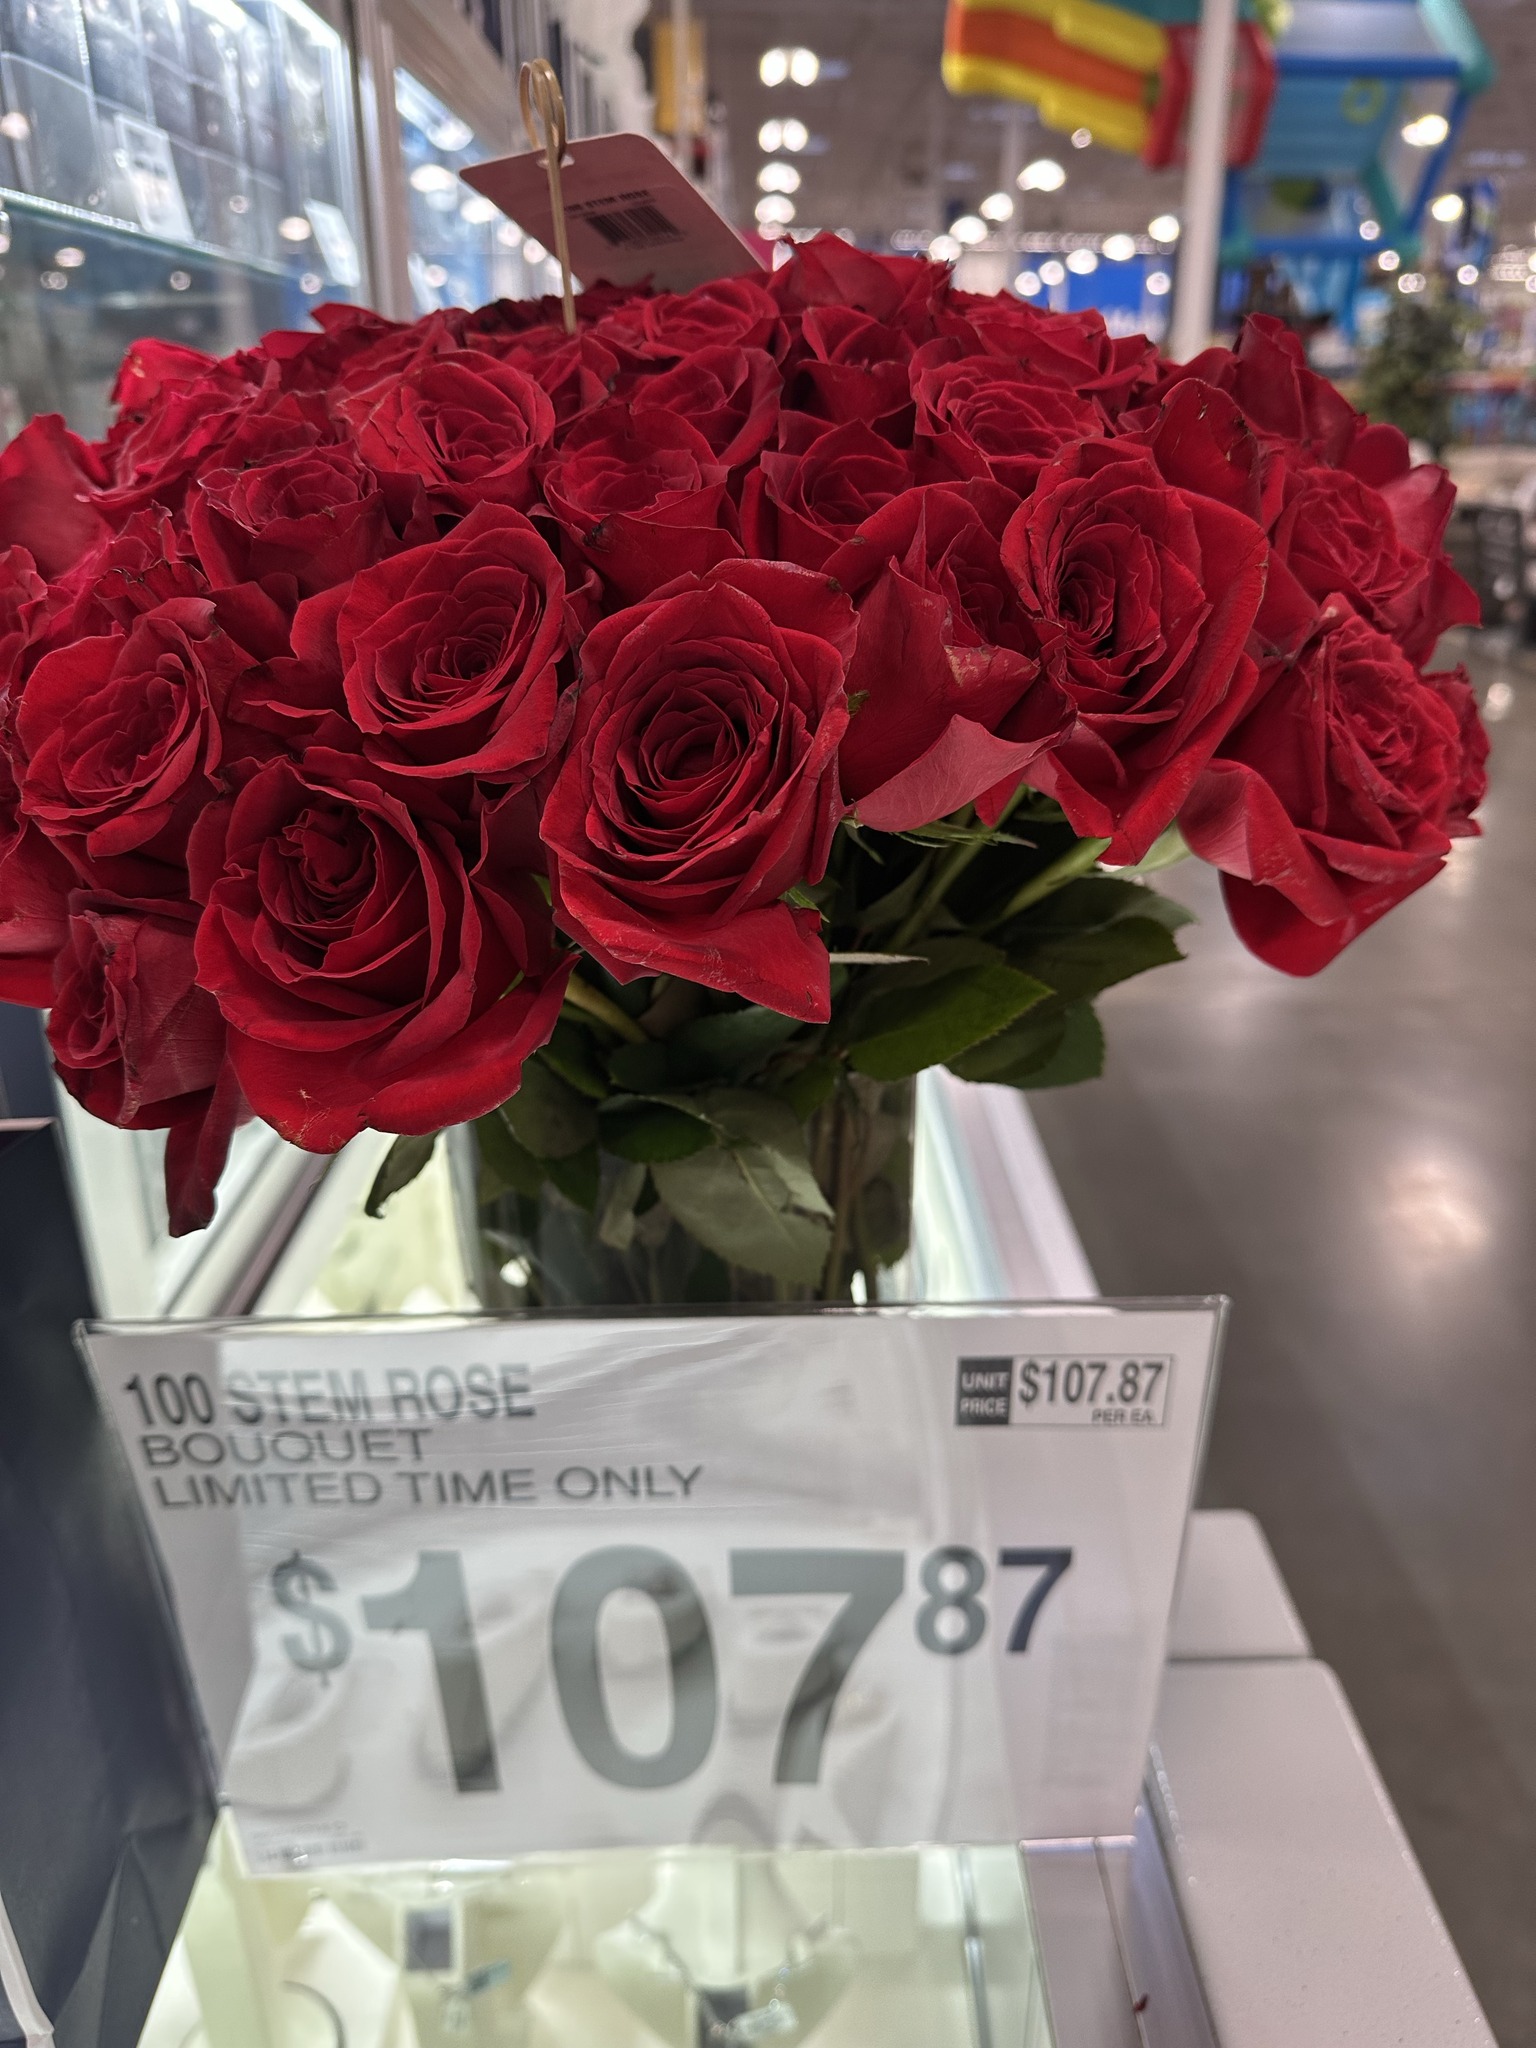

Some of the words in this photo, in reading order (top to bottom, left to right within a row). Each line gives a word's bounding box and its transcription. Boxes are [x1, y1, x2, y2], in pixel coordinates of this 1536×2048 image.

[124, 1372, 214, 1427] 100
[226, 1368, 373, 1425] STEM
[384, 1361, 537, 1424] ROSE
[961, 1371, 1009, 1393] UNIT
[1017, 1357, 1164, 1408] $107.87
[959, 1397, 1008, 1418] PRICE
[1091, 1407, 1125, 1424] PER
[140, 1427, 433, 1468] BOUQUET
[154, 1470, 384, 1508] LIMITED
[394, 1467, 538, 1505] TIME
[553, 1464, 705, 1501] ONLY
